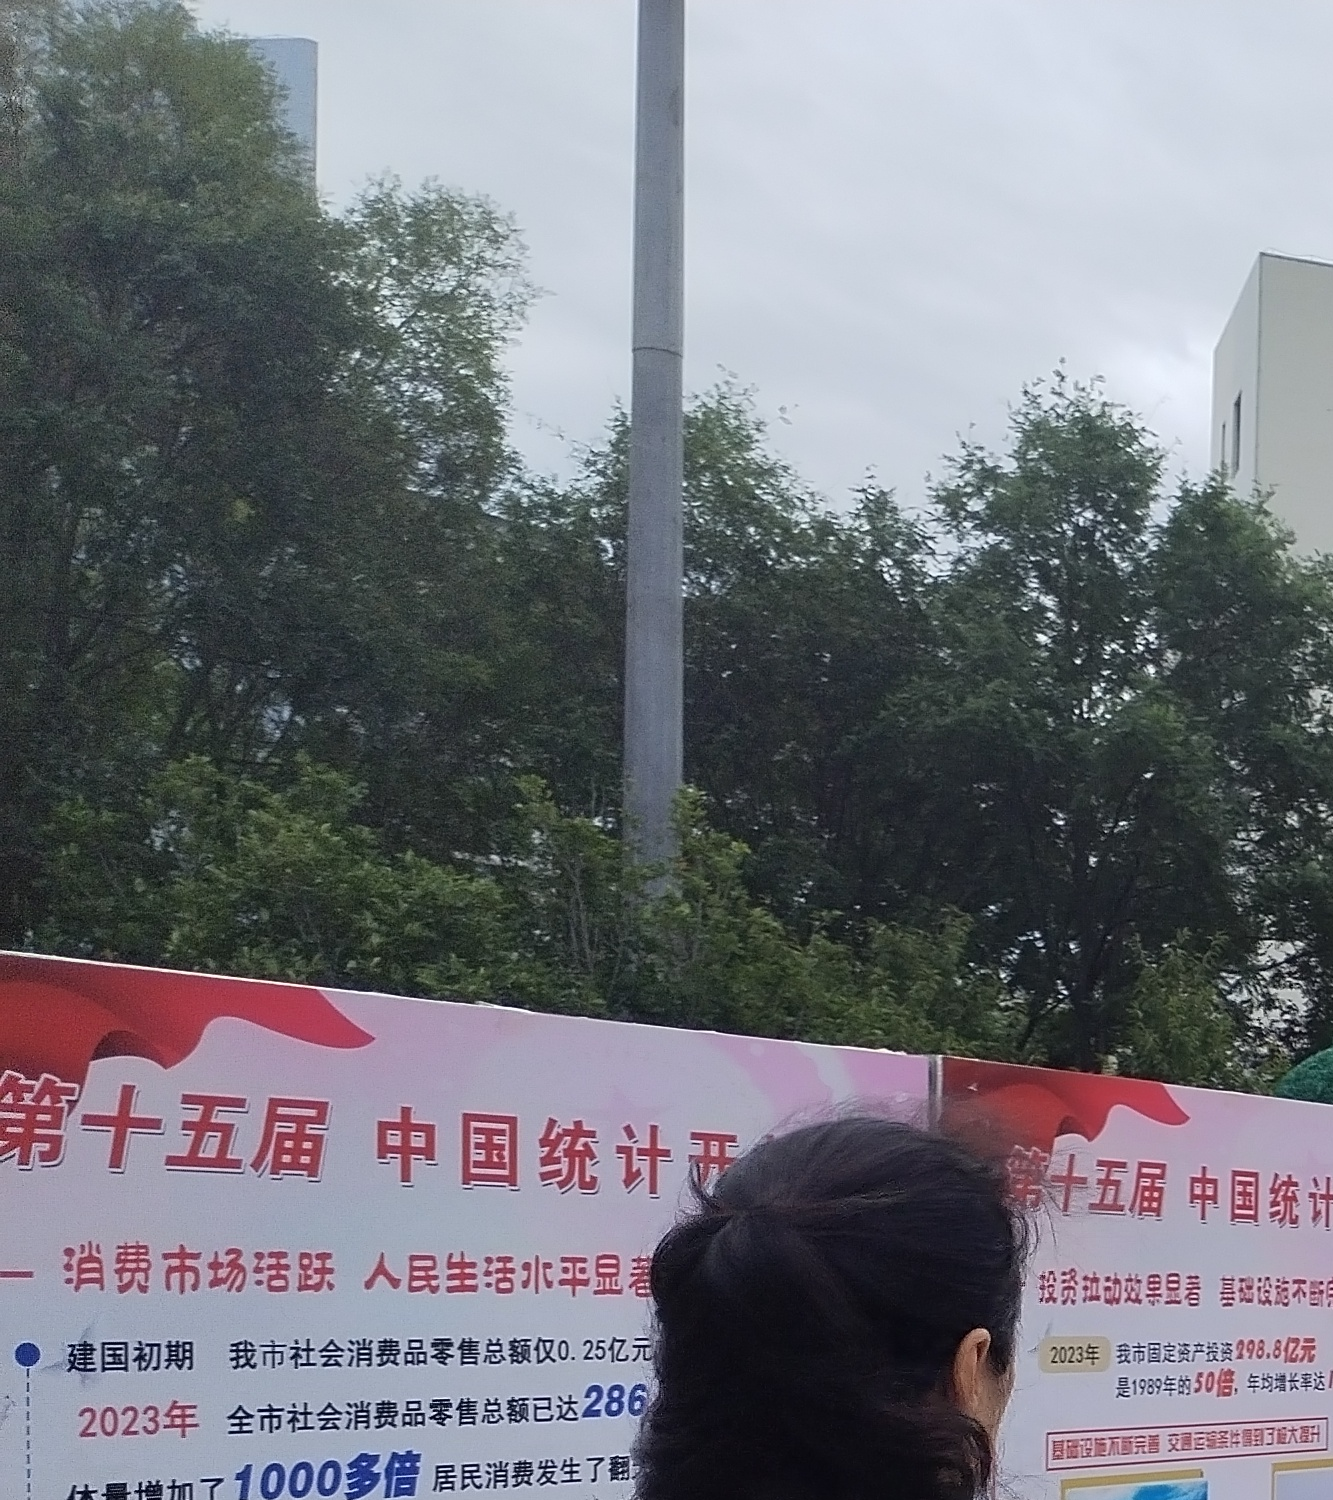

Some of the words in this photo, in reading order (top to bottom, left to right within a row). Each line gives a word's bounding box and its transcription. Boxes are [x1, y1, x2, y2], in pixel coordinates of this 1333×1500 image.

[0, 1069, 334, 1183] 第十五届
[62, 1239, 336, 1296] 消费市场活跃
[66, 1339, 195, 1374] 建国初期
[228, 1336, 652, 1372] 我市社会消费品零售总额仅0.25亿元
[1050, 1342, 1101, 1365] 2023年
[78, 1399, 200, 1439] 2023年
